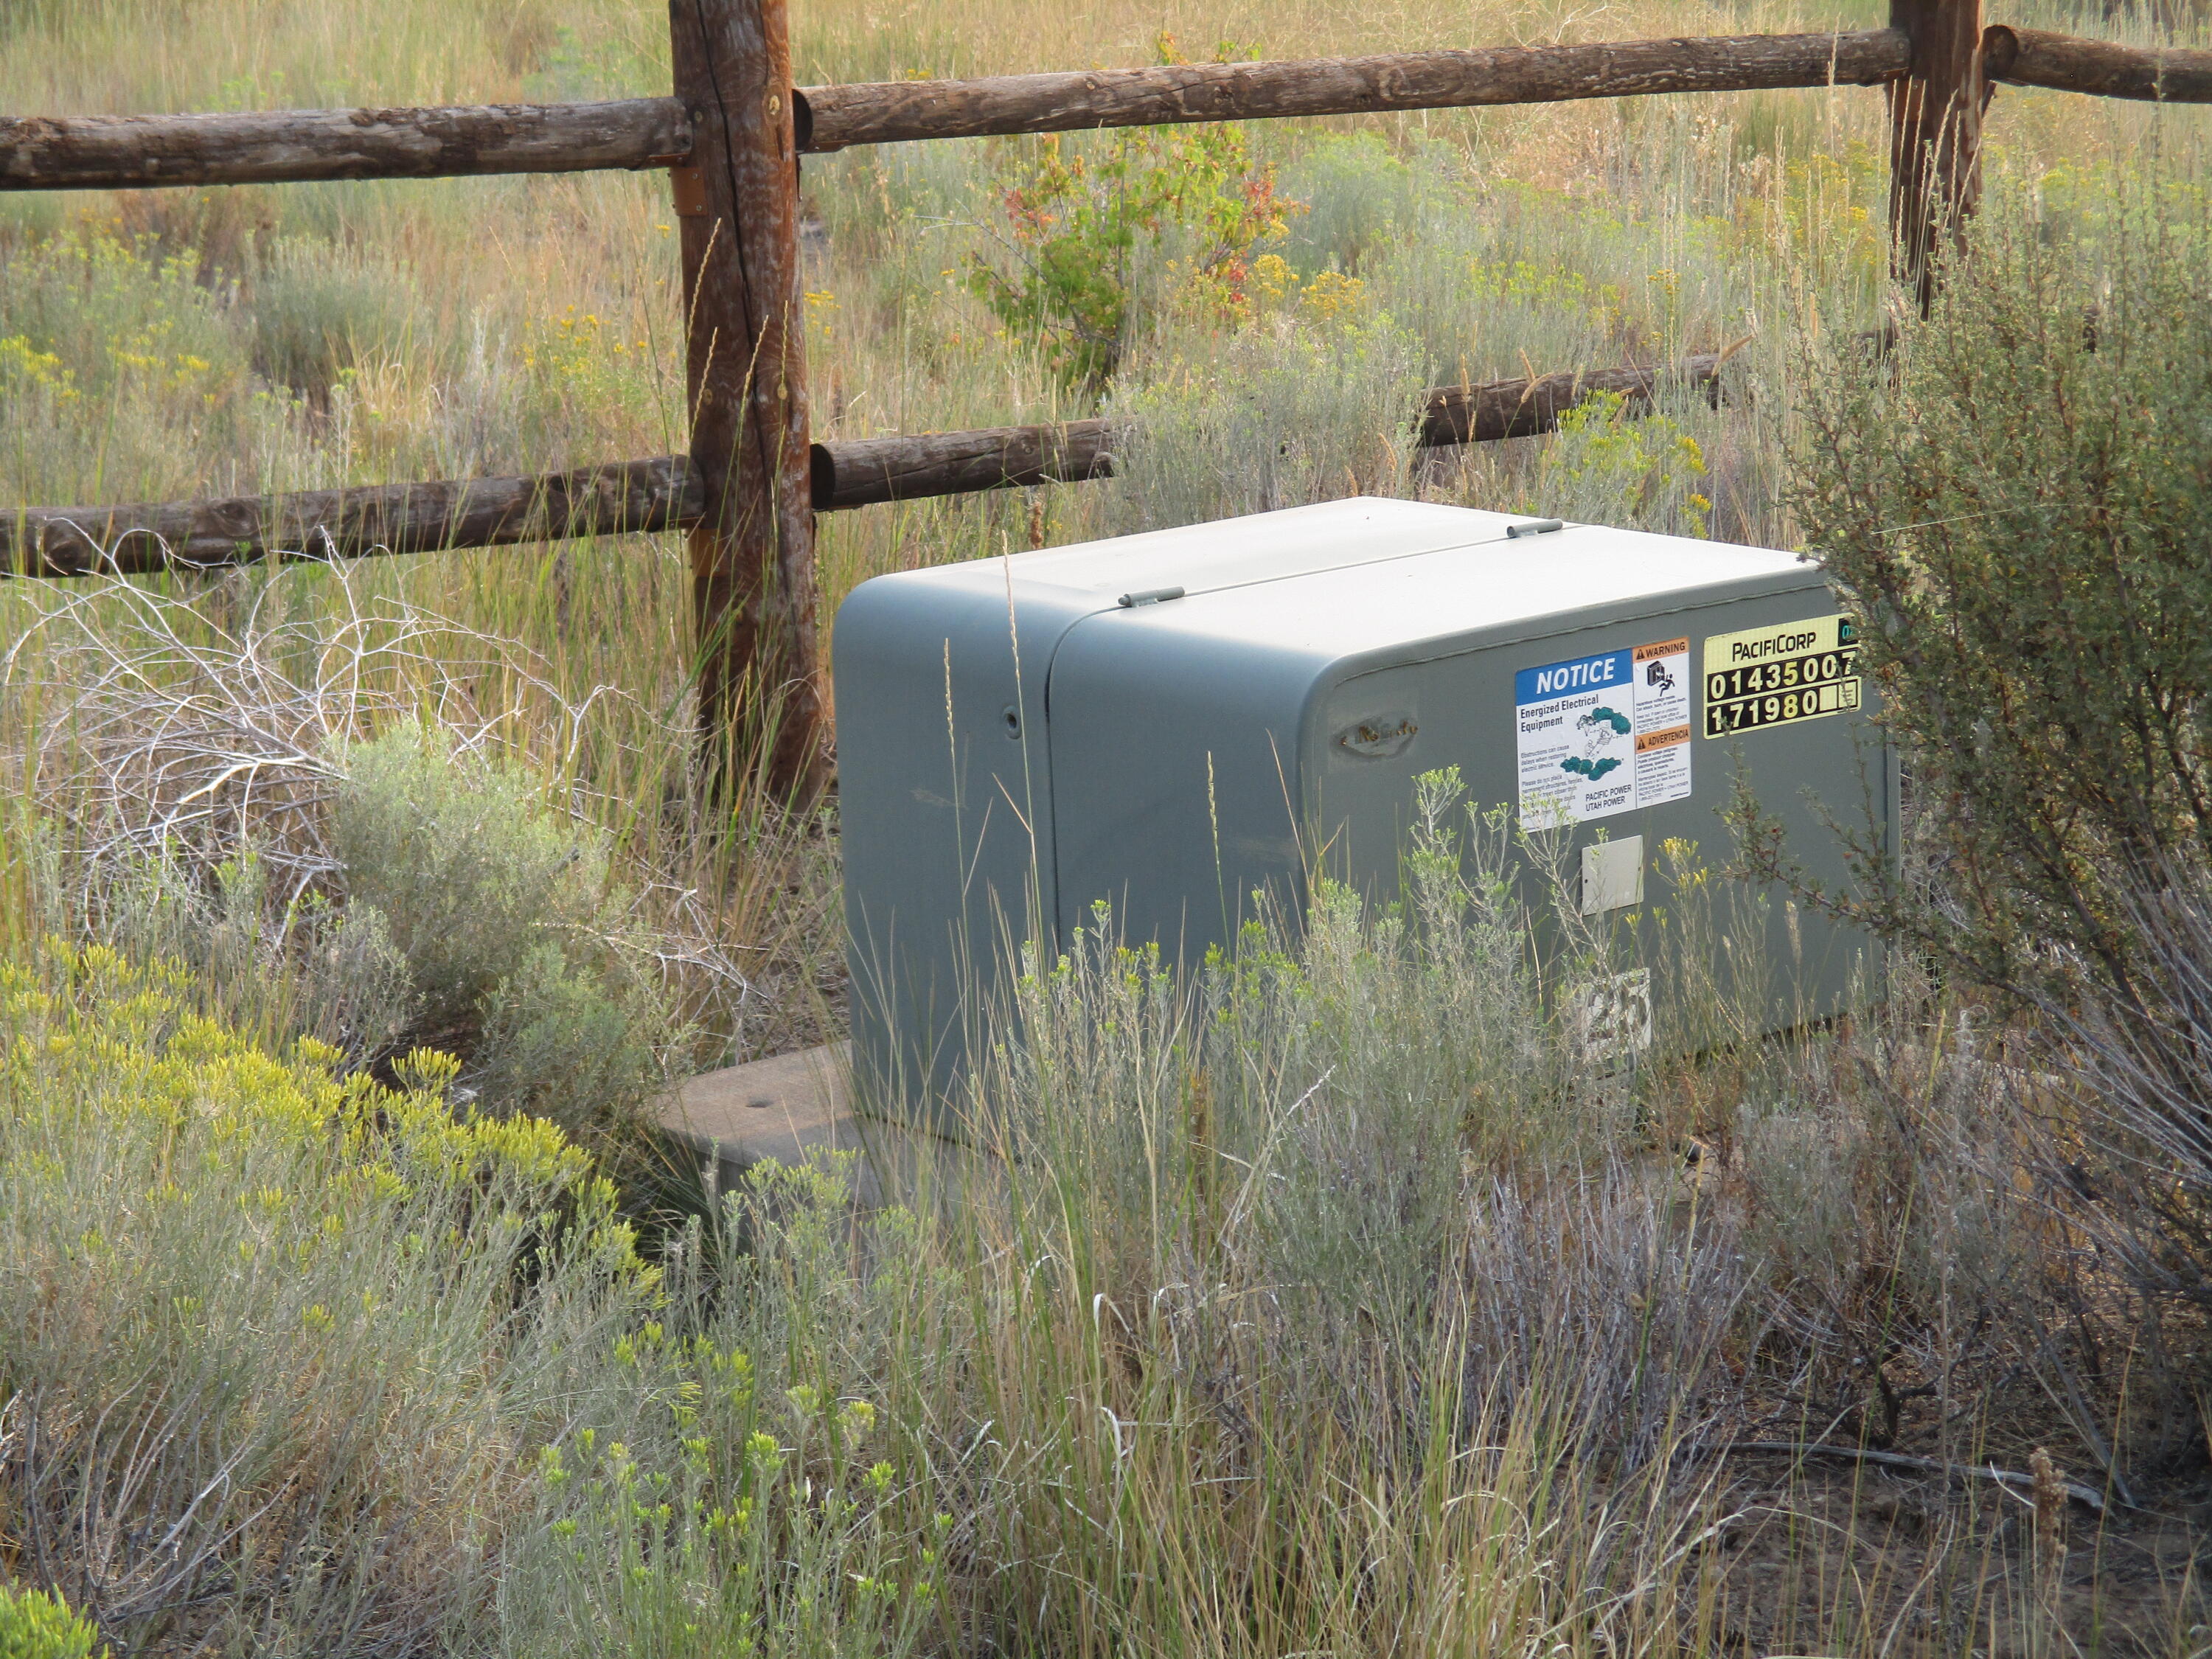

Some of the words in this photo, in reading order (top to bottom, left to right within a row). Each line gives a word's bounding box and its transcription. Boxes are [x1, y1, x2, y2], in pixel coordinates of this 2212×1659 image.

[1646, 641, 1686, 658] WARNING
[1536, 658, 1615, 695] NOTICE
[1520, 702, 1559, 719] Energized
[1562, 694, 1599, 711] Electrical
[1712, 690, 1818, 731] 171980
[1521, 716, 1563, 733] Equipment
[1648, 728, 1689, 747] ADVERTENCIA
[1585, 789, 1609, 802] PACIFIC
[1609, 784, 1632, 798] POWER
[1585, 800, 1602, 812] UTAH
[1602, 796, 1626, 809] POWER
